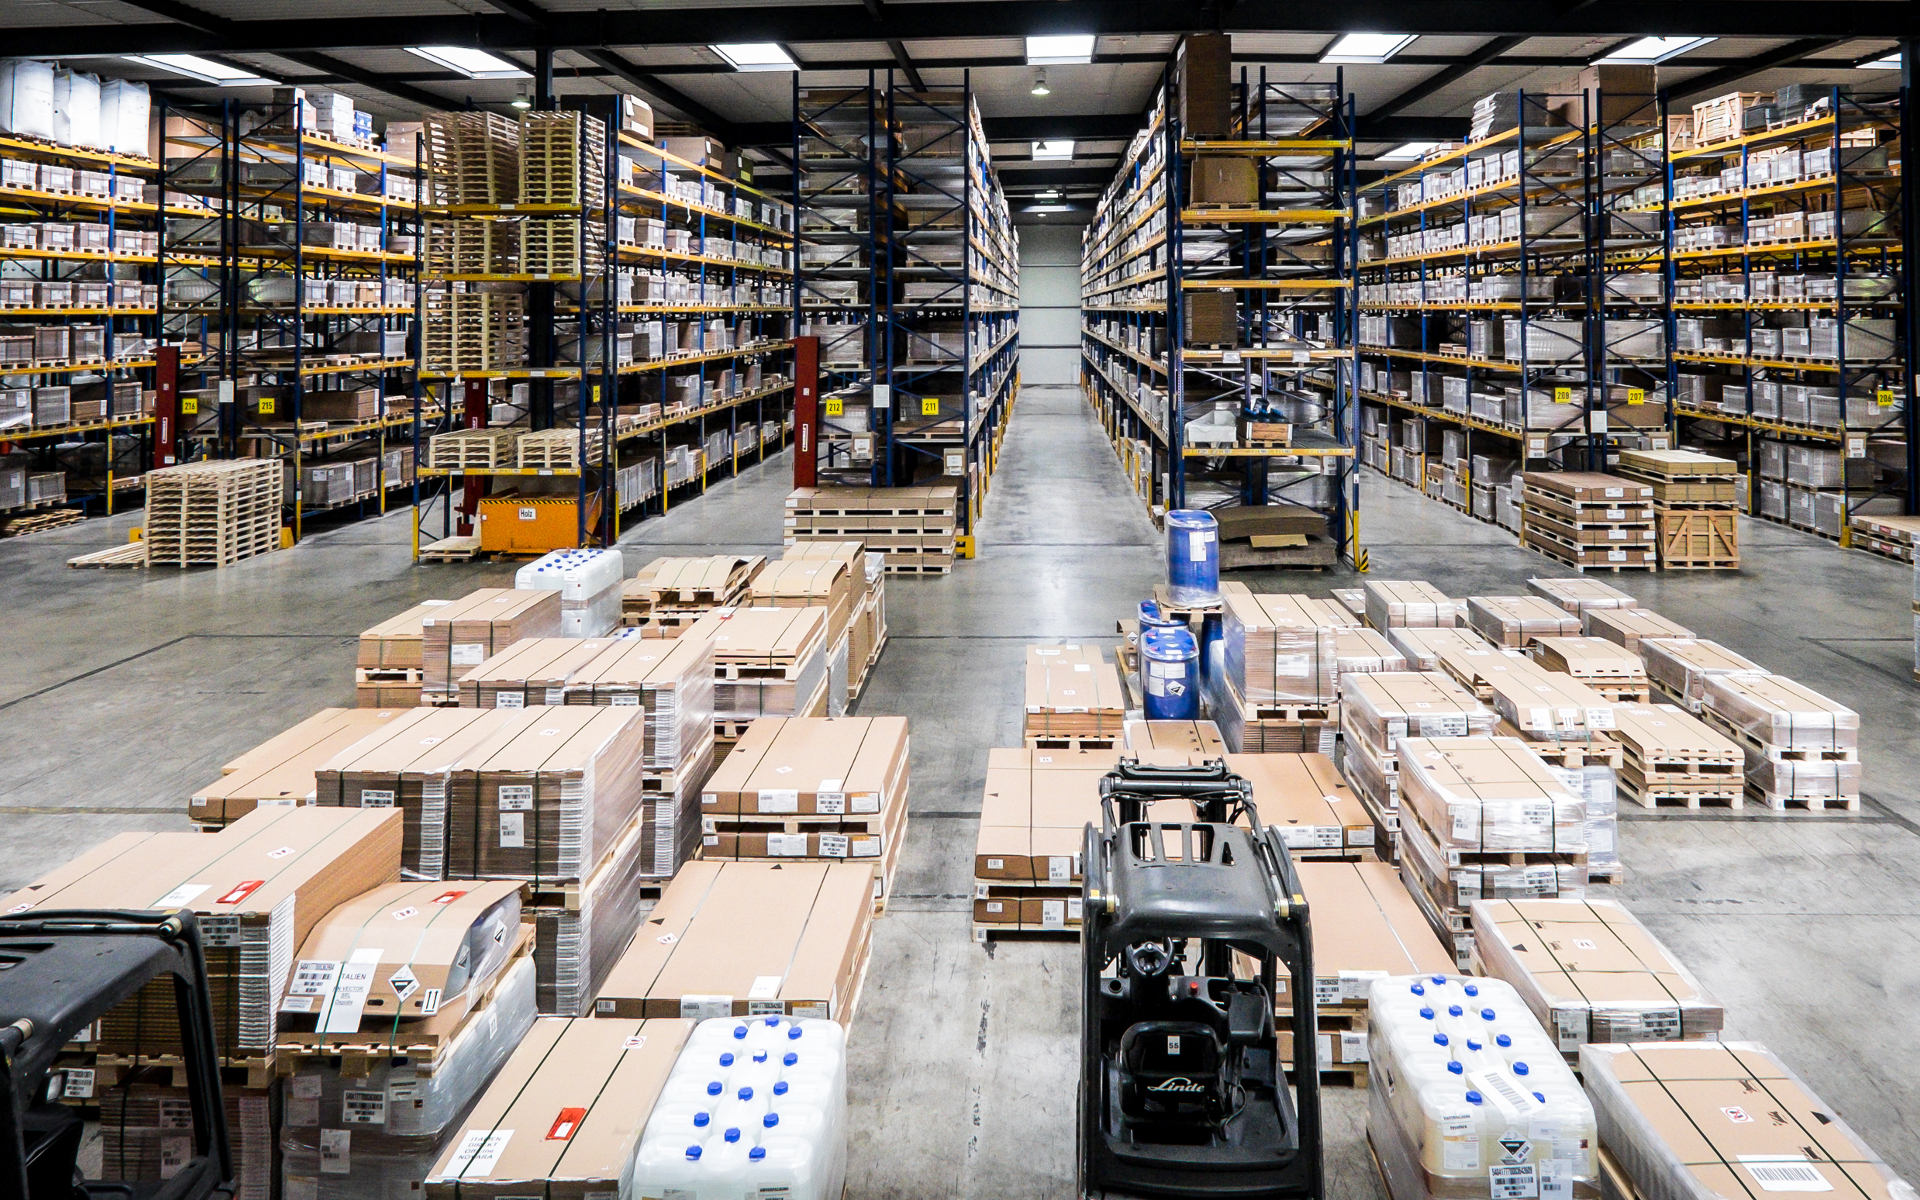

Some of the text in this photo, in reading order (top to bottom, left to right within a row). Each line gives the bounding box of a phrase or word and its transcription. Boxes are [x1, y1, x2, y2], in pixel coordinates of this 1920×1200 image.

[1629, 392, 1642, 401] 207
[184, 402, 196, 411] 216
[261, 401, 273, 410] 215
[828, 403, 841, 412] 212
[924, 402, 937, 411] 211
[520, 509, 533, 518] Holz
[1146, 1076, 1205, 1093] Linde
